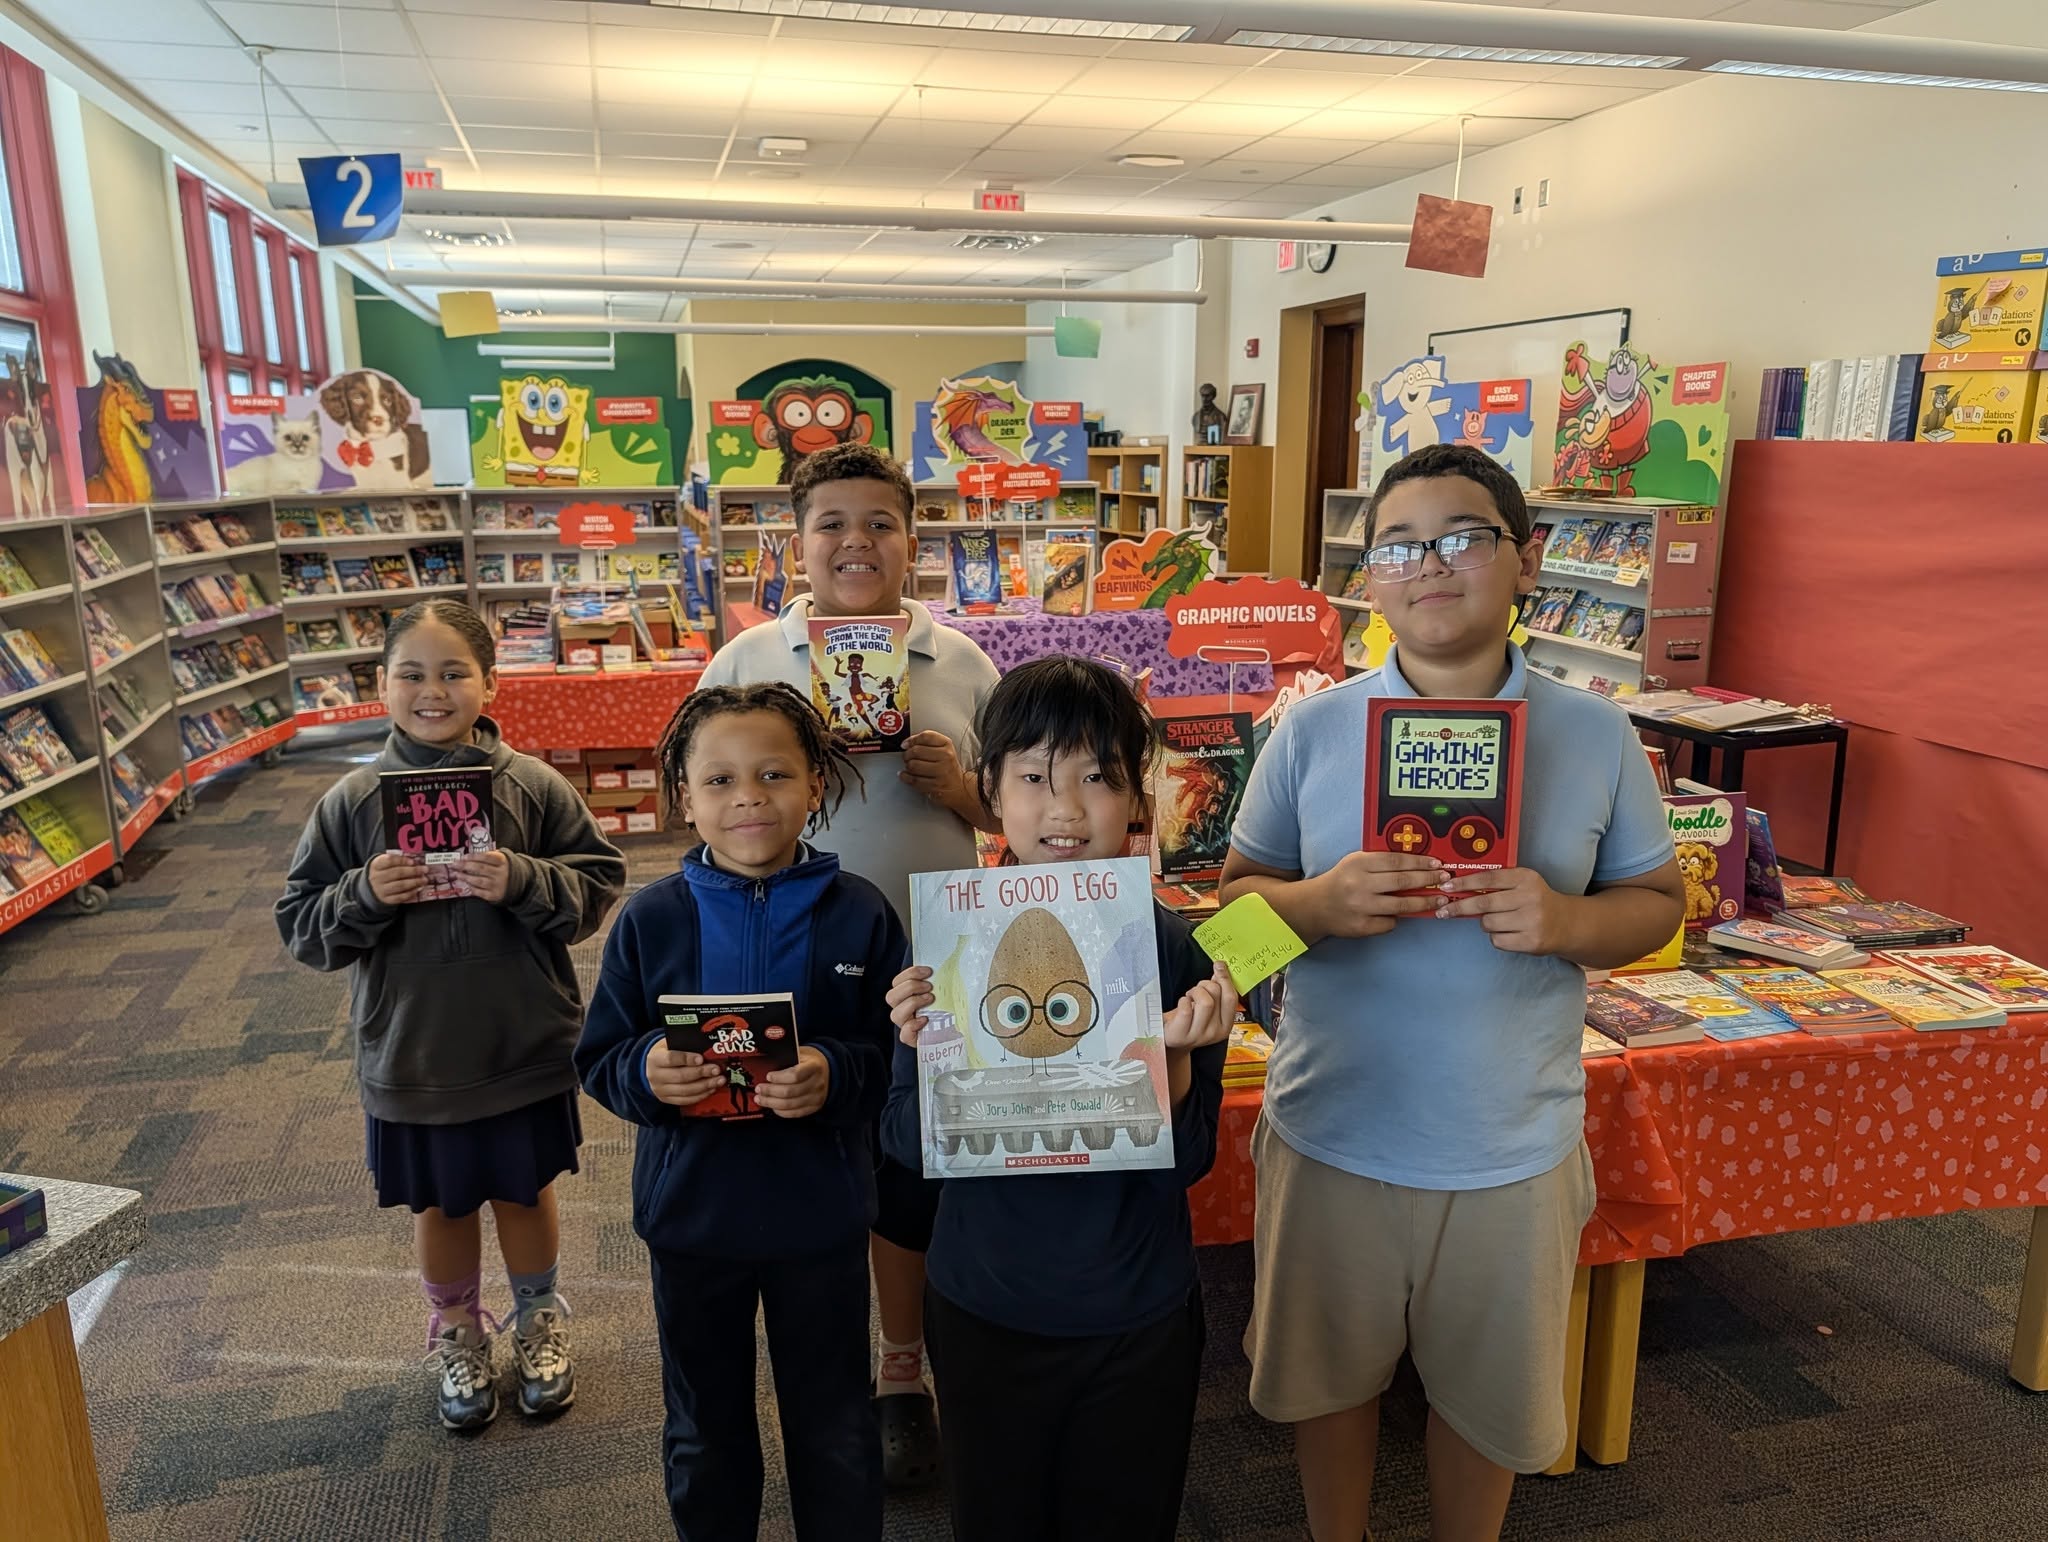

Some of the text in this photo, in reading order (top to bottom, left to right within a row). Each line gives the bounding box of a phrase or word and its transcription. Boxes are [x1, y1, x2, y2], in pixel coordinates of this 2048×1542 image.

[403, 170, 435, 189] XIT
[336, 160, 376, 229] 2
[2016, 331, 2029, 344] K
[1682, 370, 1717, 382] CHAPTER
[1493, 386, 1512, 395] EASY
[1685, 381, 1712, 391] BOOKS
[1486, 394, 1519, 403] READERS
[990, 418, 1026, 428] DRAGON'S
[1000, 427, 1016, 436] DEN
[958, 535, 991, 550] WINGS
[965, 548, 988, 560] FIRE
[1095, 580, 1153, 594] LEAFWINGS
[1177, 604, 1317, 626] GRAPHIC NOVELS
[825, 627, 852, 636] RUNNING
[860, 624, 892, 635] FLIP-FLOPS
[830, 631, 887, 644] FROM THE END
[826, 641, 893, 655] OF THE WORLD
[1166, 718, 1237, 741] STRANGER
[1414, 730, 1440, 738] HEAD
[1453, 731, 1479, 739] HEAD
[1179, 733, 1225, 747] THINGS
[1161, 750, 1200, 761] DUNGEONS
[1210, 748, 1246, 758] DRAGONS
[1395, 741, 1496, 765] GAMING
[1397, 767, 1490, 791] HEROES
[396, 790, 479, 825] the BAD
[1463, 826, 1472, 836] A
[1675, 829, 1719, 840] CAVOODLE
[945, 871, 1118, 913] THE GOOD EGG
[1105, 976, 1130, 995] milk
[717, 1029, 754, 1042] BAD
[712, 1040, 756, 1055] GUYS
[986, 1096, 1102, 1117] Jory John and Pete Oswald
[1017, 1154, 1089, 1167] SCHOLASTIC
